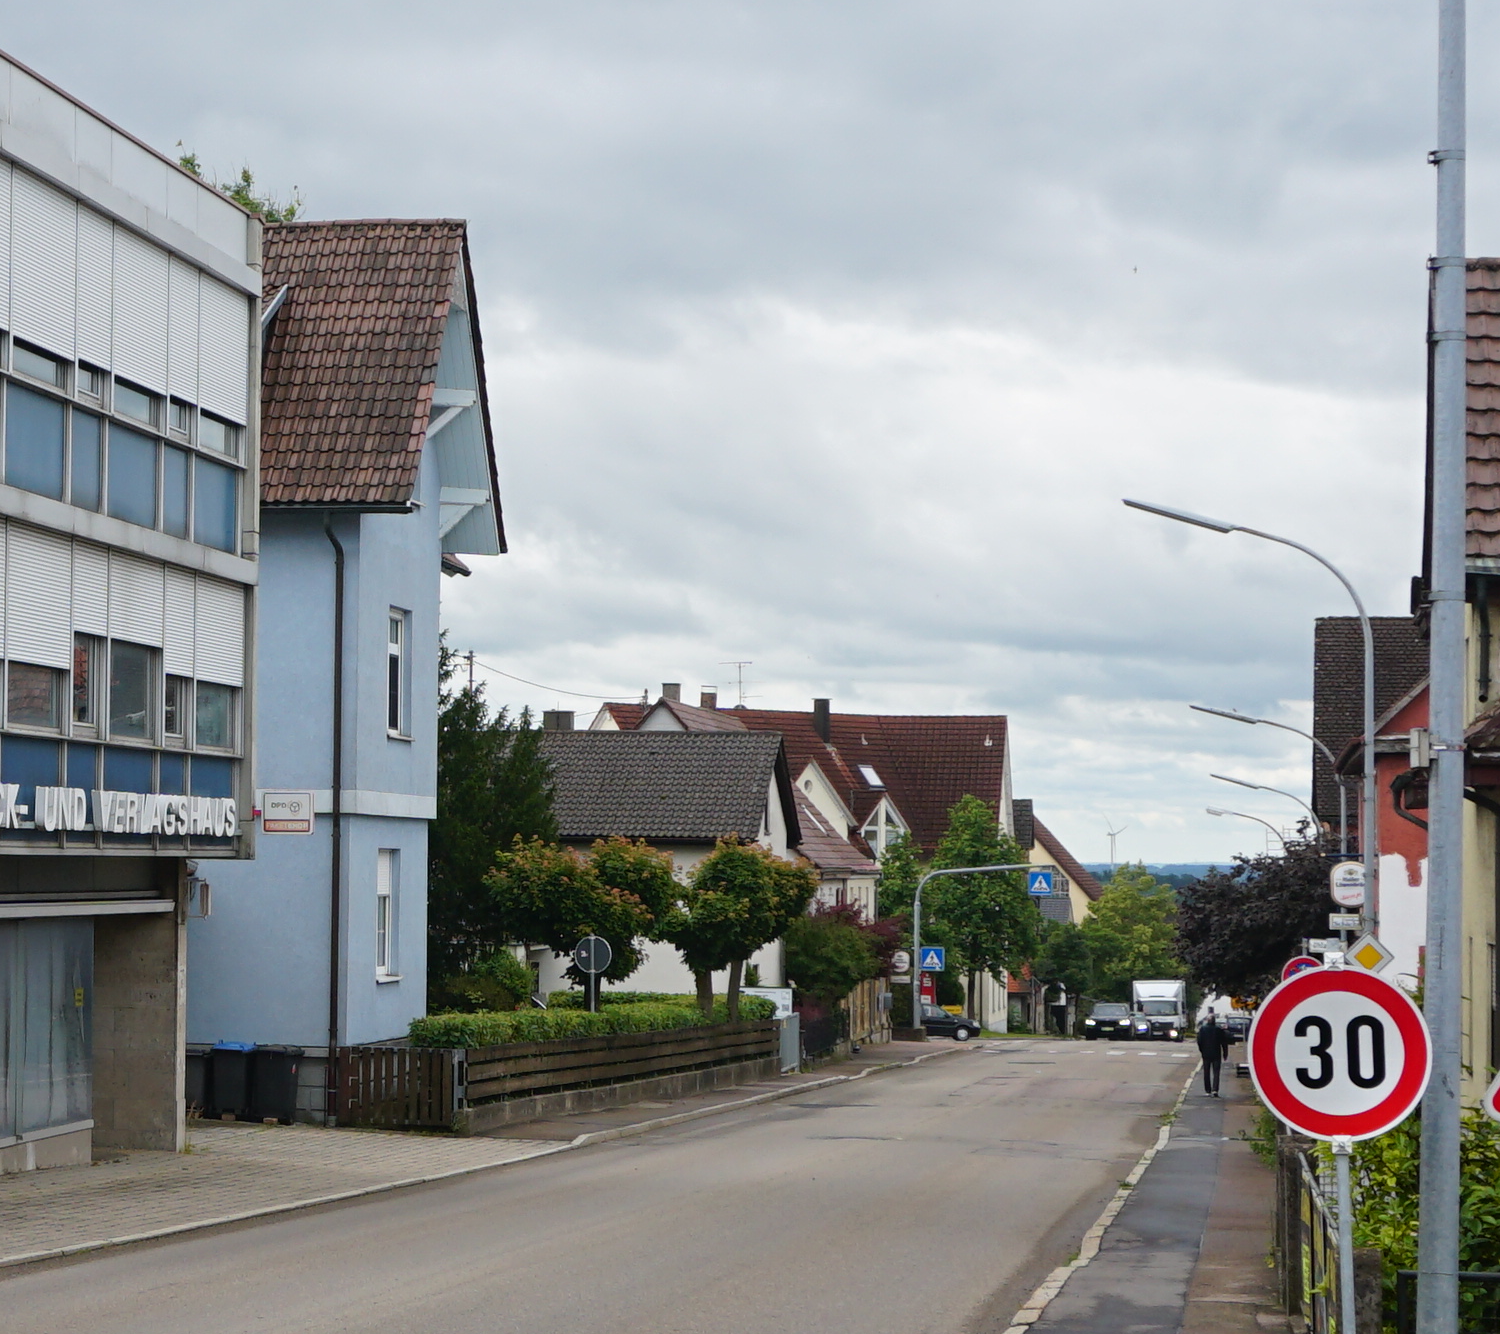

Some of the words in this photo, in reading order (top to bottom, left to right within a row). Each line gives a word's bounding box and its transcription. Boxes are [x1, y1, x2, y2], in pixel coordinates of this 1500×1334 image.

[35, 785, 87, 832] UND
[91, 789, 237, 837] VERLAGSHAUS
[1294, 1014, 1386, 1089] 30
